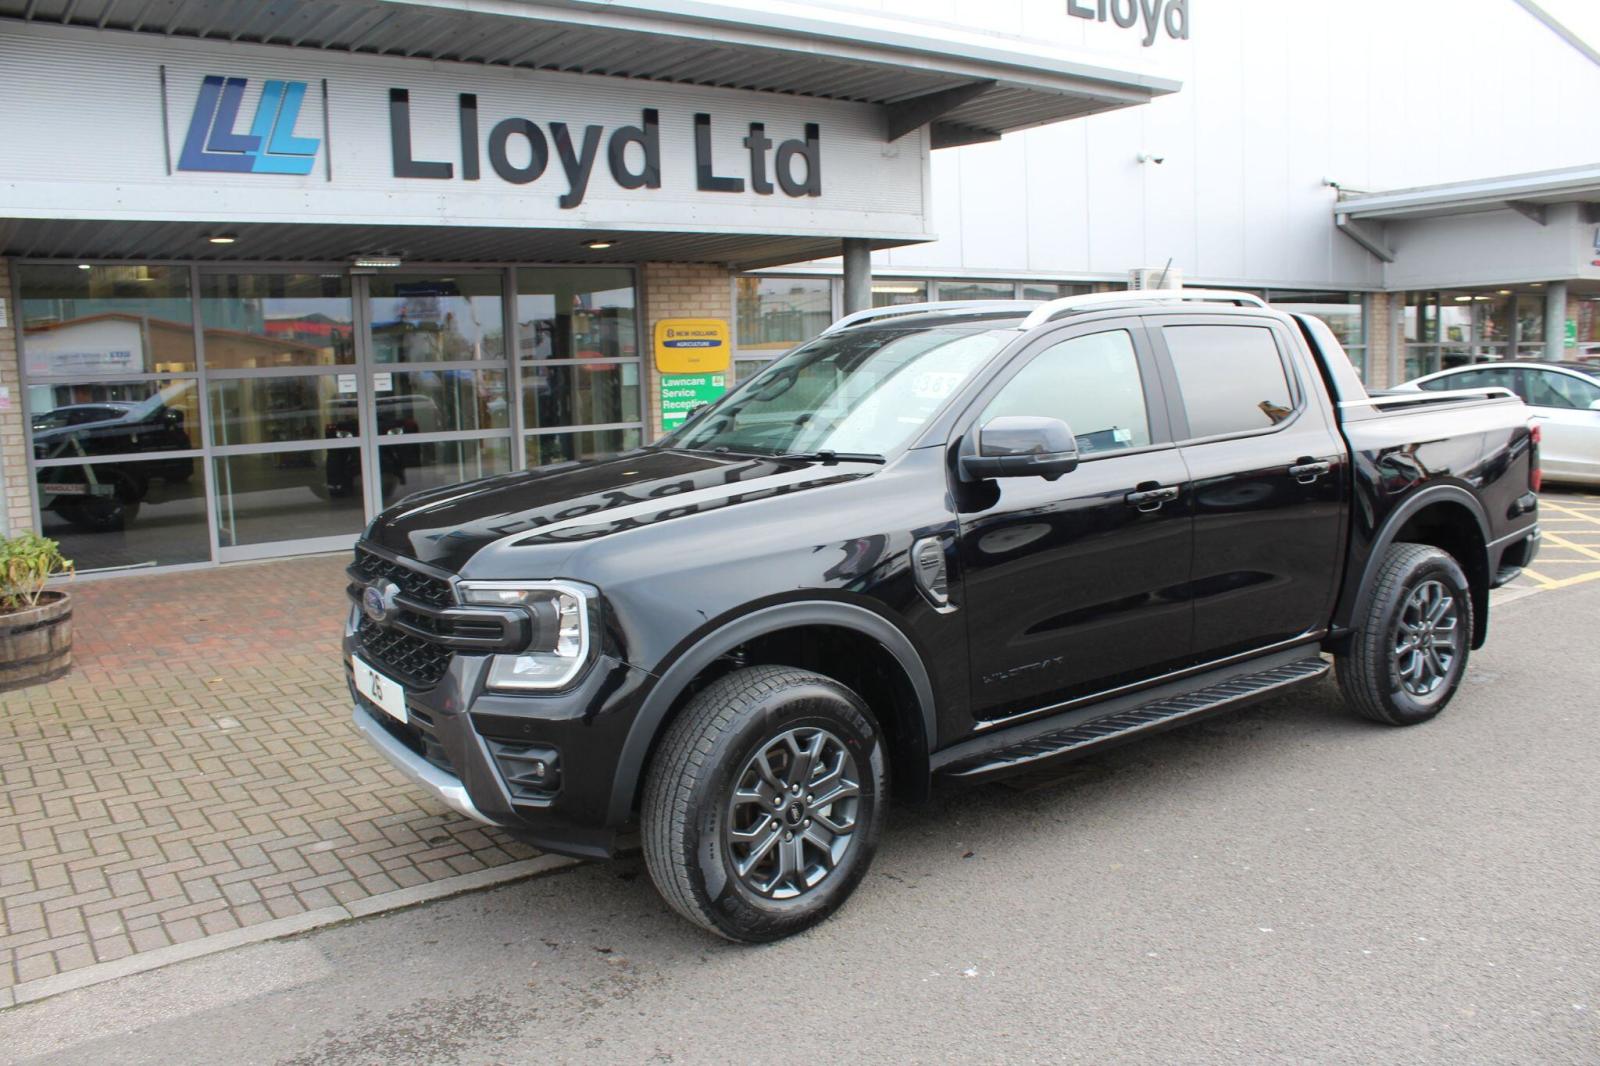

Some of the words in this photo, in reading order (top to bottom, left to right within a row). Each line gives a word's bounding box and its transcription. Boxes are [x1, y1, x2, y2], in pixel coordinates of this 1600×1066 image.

[389, 88, 661, 209] Lloyd
[694, 112, 822, 198] Ltd
[662, 377, 705, 387] Lawncare
[662, 389, 697, 398] Service
